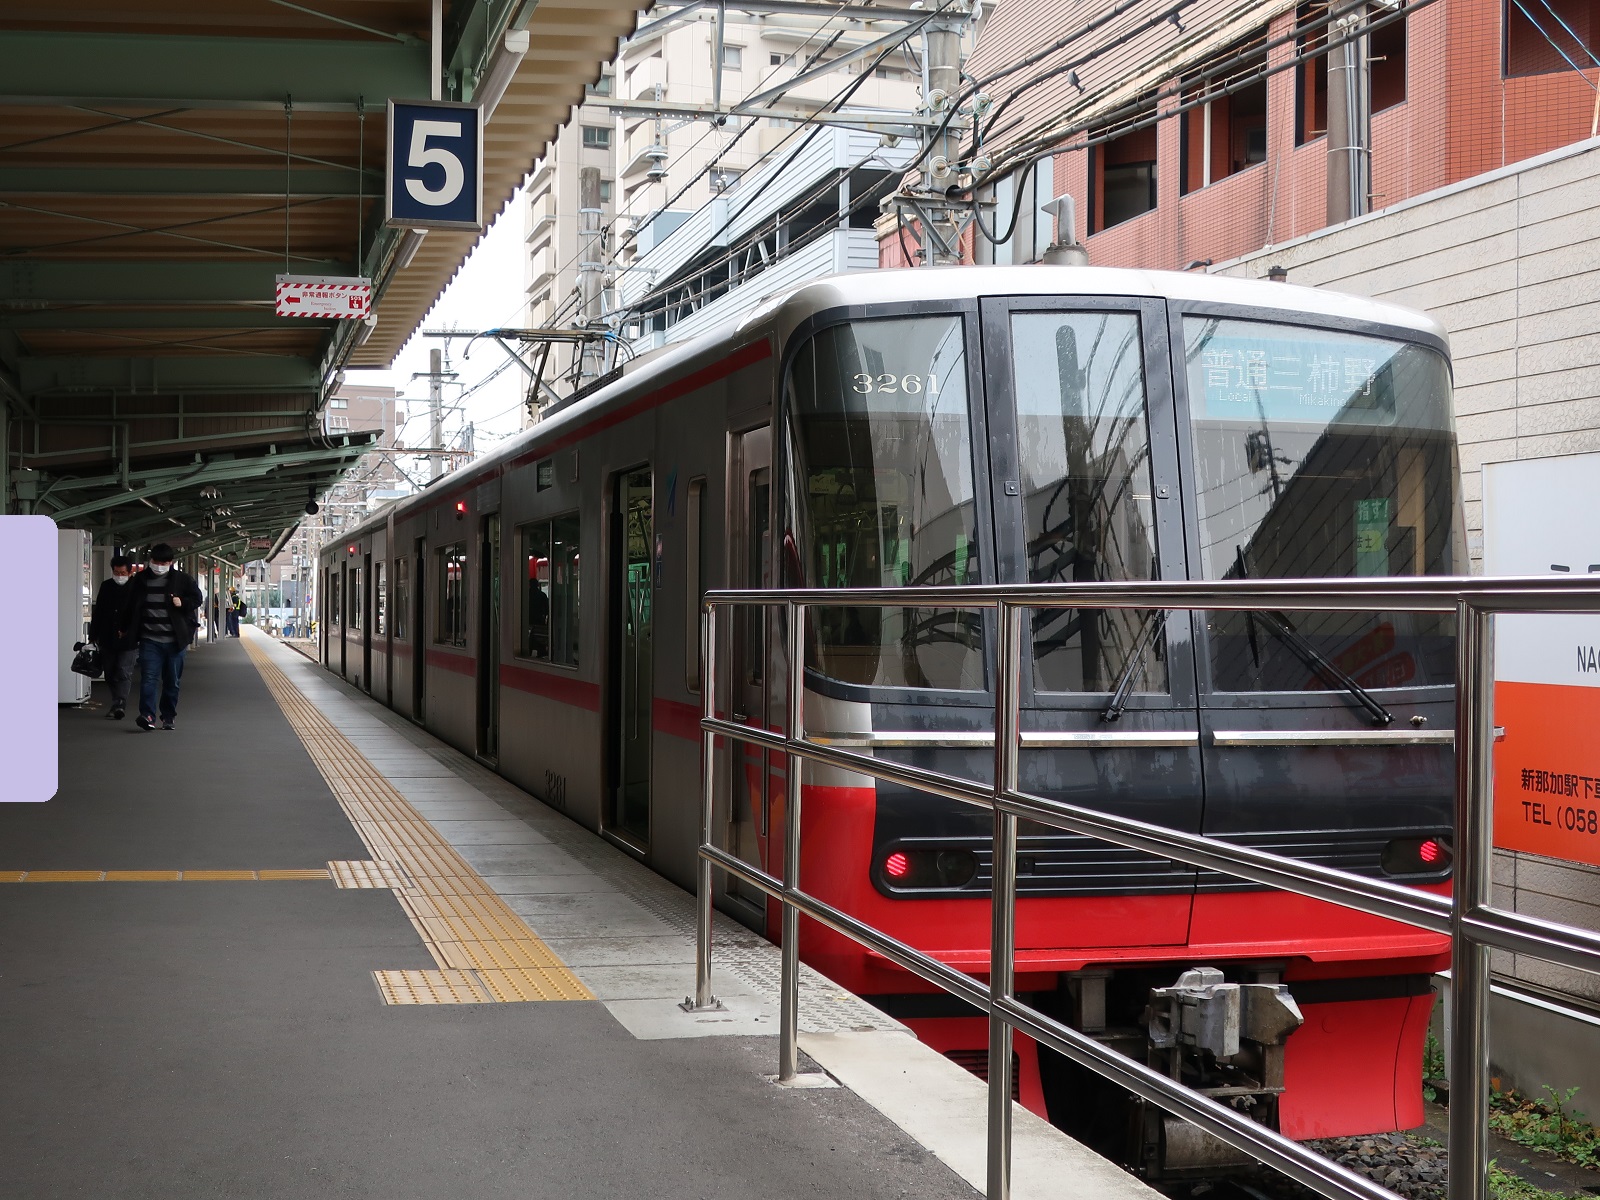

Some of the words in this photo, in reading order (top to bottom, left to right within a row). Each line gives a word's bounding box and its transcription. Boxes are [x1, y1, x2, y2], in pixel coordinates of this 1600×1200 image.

[404, 119, 465, 207] 5
[302, 291, 347, 299] 非常通報ボタン
[852, 373, 939, 394] 3261
[1218, 389, 1252, 402] Local
[1299, 393, 1347, 407] Mikakino
[1577, 645, 1600, 673] NA
[1522, 801, 1552, 826] TEL
